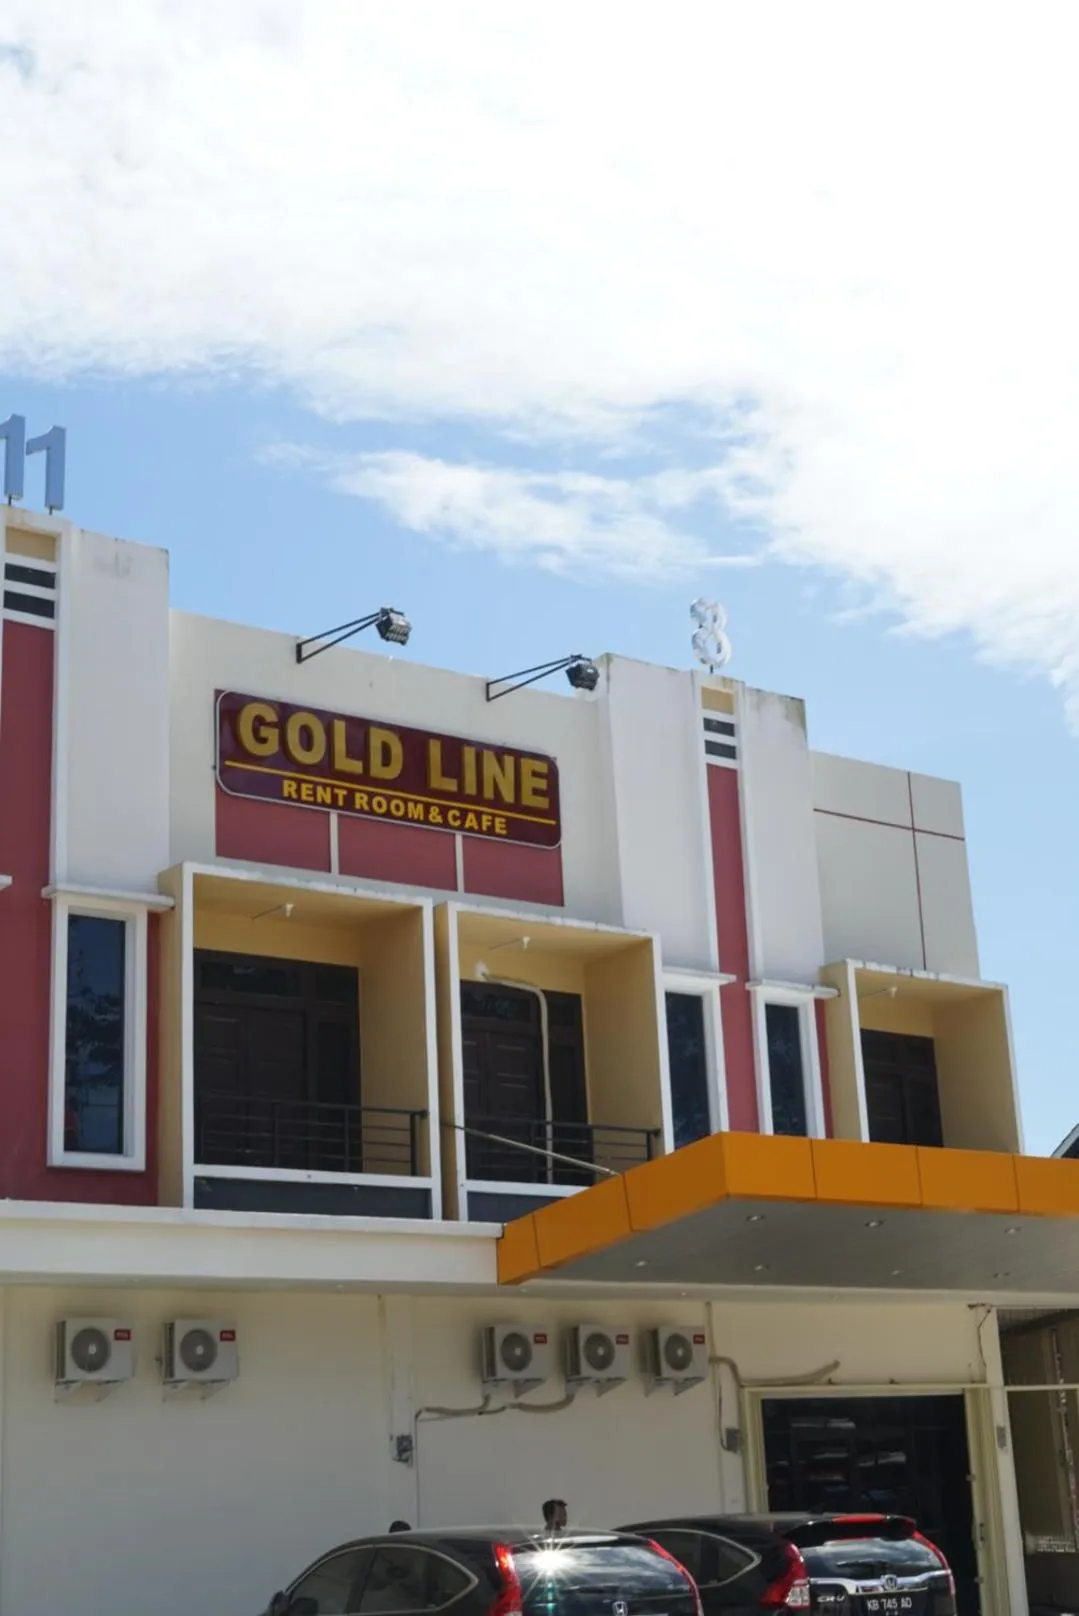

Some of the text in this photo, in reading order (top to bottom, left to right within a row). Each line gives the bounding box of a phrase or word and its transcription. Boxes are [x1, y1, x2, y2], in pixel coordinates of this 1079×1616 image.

[690, 598, 732, 668] 8
[238, 702, 550, 809] GOLD LINE
[282, 779, 348, 806] RENT
[867, 1599, 879, 1610] KB
[881, 1599, 898, 1610] 745
